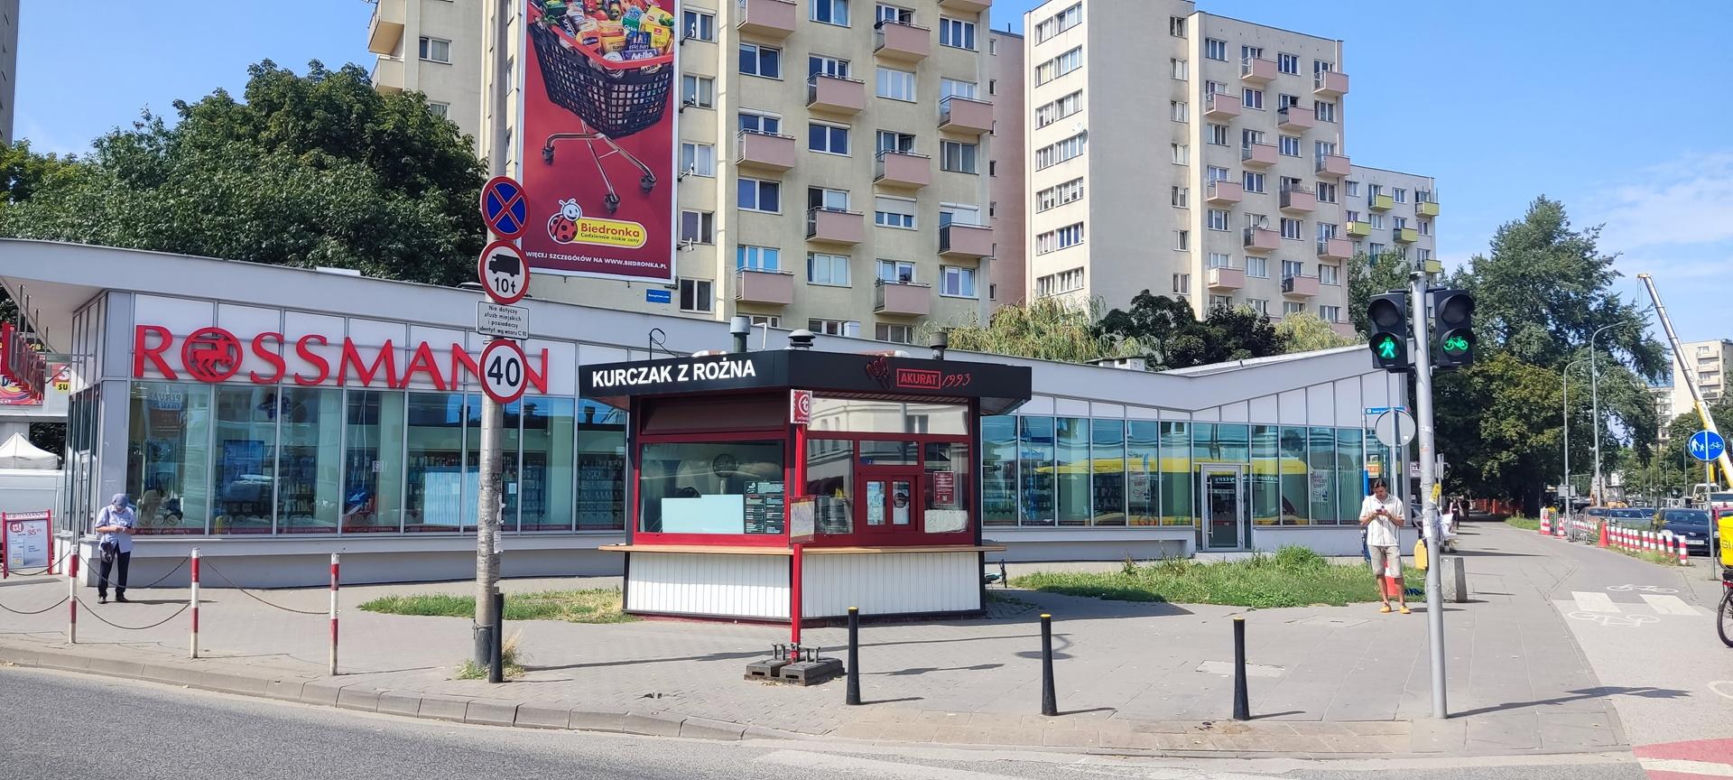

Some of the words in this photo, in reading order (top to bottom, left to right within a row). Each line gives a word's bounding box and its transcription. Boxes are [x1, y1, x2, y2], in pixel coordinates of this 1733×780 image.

[581, 223, 640, 238] Biedronka
[525, 251, 548, 259] WIĘCEJ
[549, 253, 592, 263] SZCZEGÓŁÓW
[605, 258, 667, 270] WWW.BIEDRONKA.PL
[495, 277, 509, 293] 10
[511, 280, 516, 294] t
[499, 307, 518, 315] dotyczy
[487, 356, 521, 387] 40
[592, 365, 673, 388] KURCZAK
[677, 364, 689, 382] Z
[693, 357, 756, 381] ROŻNA
[900, 372, 938, 385] AKURAT
[941, 372, 972, 388] 1993
